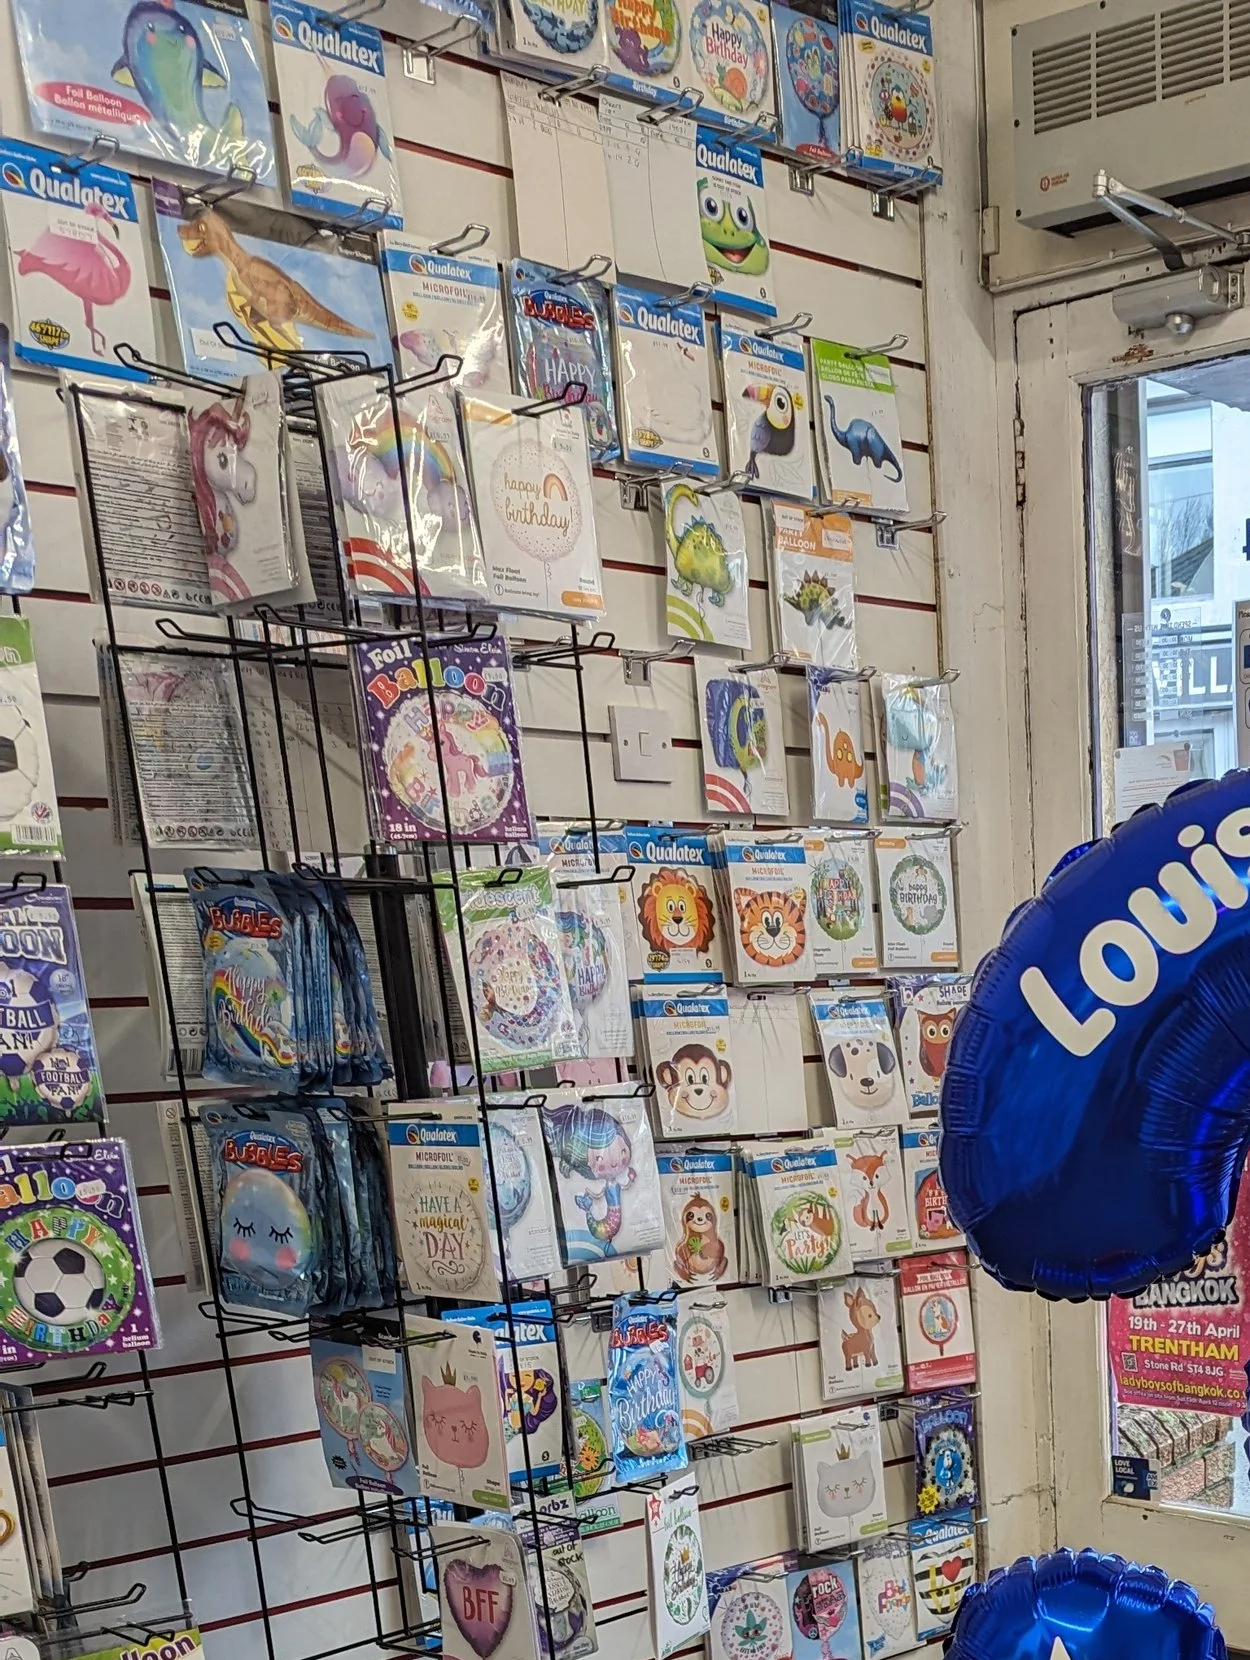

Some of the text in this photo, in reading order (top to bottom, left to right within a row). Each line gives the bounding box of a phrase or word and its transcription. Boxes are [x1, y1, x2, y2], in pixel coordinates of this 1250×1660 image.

[711, 22, 743, 49] Happy
[871, 15, 926, 53] Qualatex
[298, 20, 380, 73] Qualatex
[705, 35, 749, 69] Birthday
[66, 85, 122, 108] Foil Balloon
[54, 93, 143, 125] Ballon métallique
[696, 144, 758, 185] Qualatex
[30, 169, 130, 220] Qualatex
[427, 260, 473, 282] Qualatex
[422, 282, 467, 297] MICROFOIL
[523, 296, 596, 331] BUBBLES
[637, 306, 701, 342] Qualatex
[752, 341, 785, 364] Qualatex
[544, 358, 596, 390] HAPPY
[748, 360, 782, 377] MICROFOIL
[504, 472, 541, 500] happy
[505, 496, 574, 538] birthday!
[778, 536, 816, 551] BALLOON
[367, 639, 412, 671] Foil
[368, 658, 506, 711] Balloon
[388, 815, 518, 833] 18 in 1
[504, 825, 527, 834] helium
[646, 836, 705, 864] Qualatex
[754, 849, 788, 861] Qualatex
[751, 866, 785, 876] MICROFOIL
[900, 892, 939, 905] BIRTHDAY
[908, 883, 928, 895] happy
[208, 904, 283, 939] BUBBLES
[224, 964, 269, 1002] Happy
[578, 964, 607, 986] HAPPY
[940, 984, 968, 997] SHAPE
[676, 1002, 711, 1014] Qualatex
[40, 1070, 87, 1086] FOOTBALL
[49, 1086, 80, 1097] FAN!
[250, 1132, 276, 1143] Qualatex
[419, 1127, 457, 1144] Qualatex
[94, 1147, 120, 1161] Elvin
[224, 1139, 304, 1173] BUBBLES
[415, 1151, 454, 1163] MICROFOIL
[684, 1158, 716, 1171] Qualatex
[784, 1156, 817, 1170] Qualatex
[679, 1176, 713, 1186] MICROFOIL
[780, 1172, 816, 1183] MICROFOIL
[419, 1196, 462, 1214] HAVE A
[5, 1215, 104, 1252] HAPPY
[419, 1214, 467, 1233] magical
[424, 1232, 466, 1261] DAY
[794, 1230, 812, 1242] LET'S
[784, 1236, 832, 1262] Party!
[1135, 1278, 1238, 1307] BANGKOK
[5, 1294, 125, 1348] BIRTHDAY
[130, 1324, 138, 1334] 1
[1128, 1316, 1240, 1339] 19th 27th April
[122, 1334, 150, 1343] helium
[122, 1340, 151, 1349] balloon
[612, 1322, 670, 1349] BUBBLES
[1130, 1335, 1239, 1362] TRENTHAM
[1144, 1360, 1225, 1377] Stone Rd ST4 8JG
[626, 1370, 657, 1399] HAPPY
[618, 1390, 678, 1432] Birthday
[920, 1412, 968, 1434] BALLOON
[1115, 1459, 1131, 1467] LOVE
[1115, 1466, 1135, 1475] LOCAL
[540, 1498, 570, 1514] orbz
[924, 1527, 970, 1545] Qualatex
[552, 1543, 578, 1556] out of
[812, 1575, 839, 1599] rock
[462, 1586, 500, 1625] BFF
